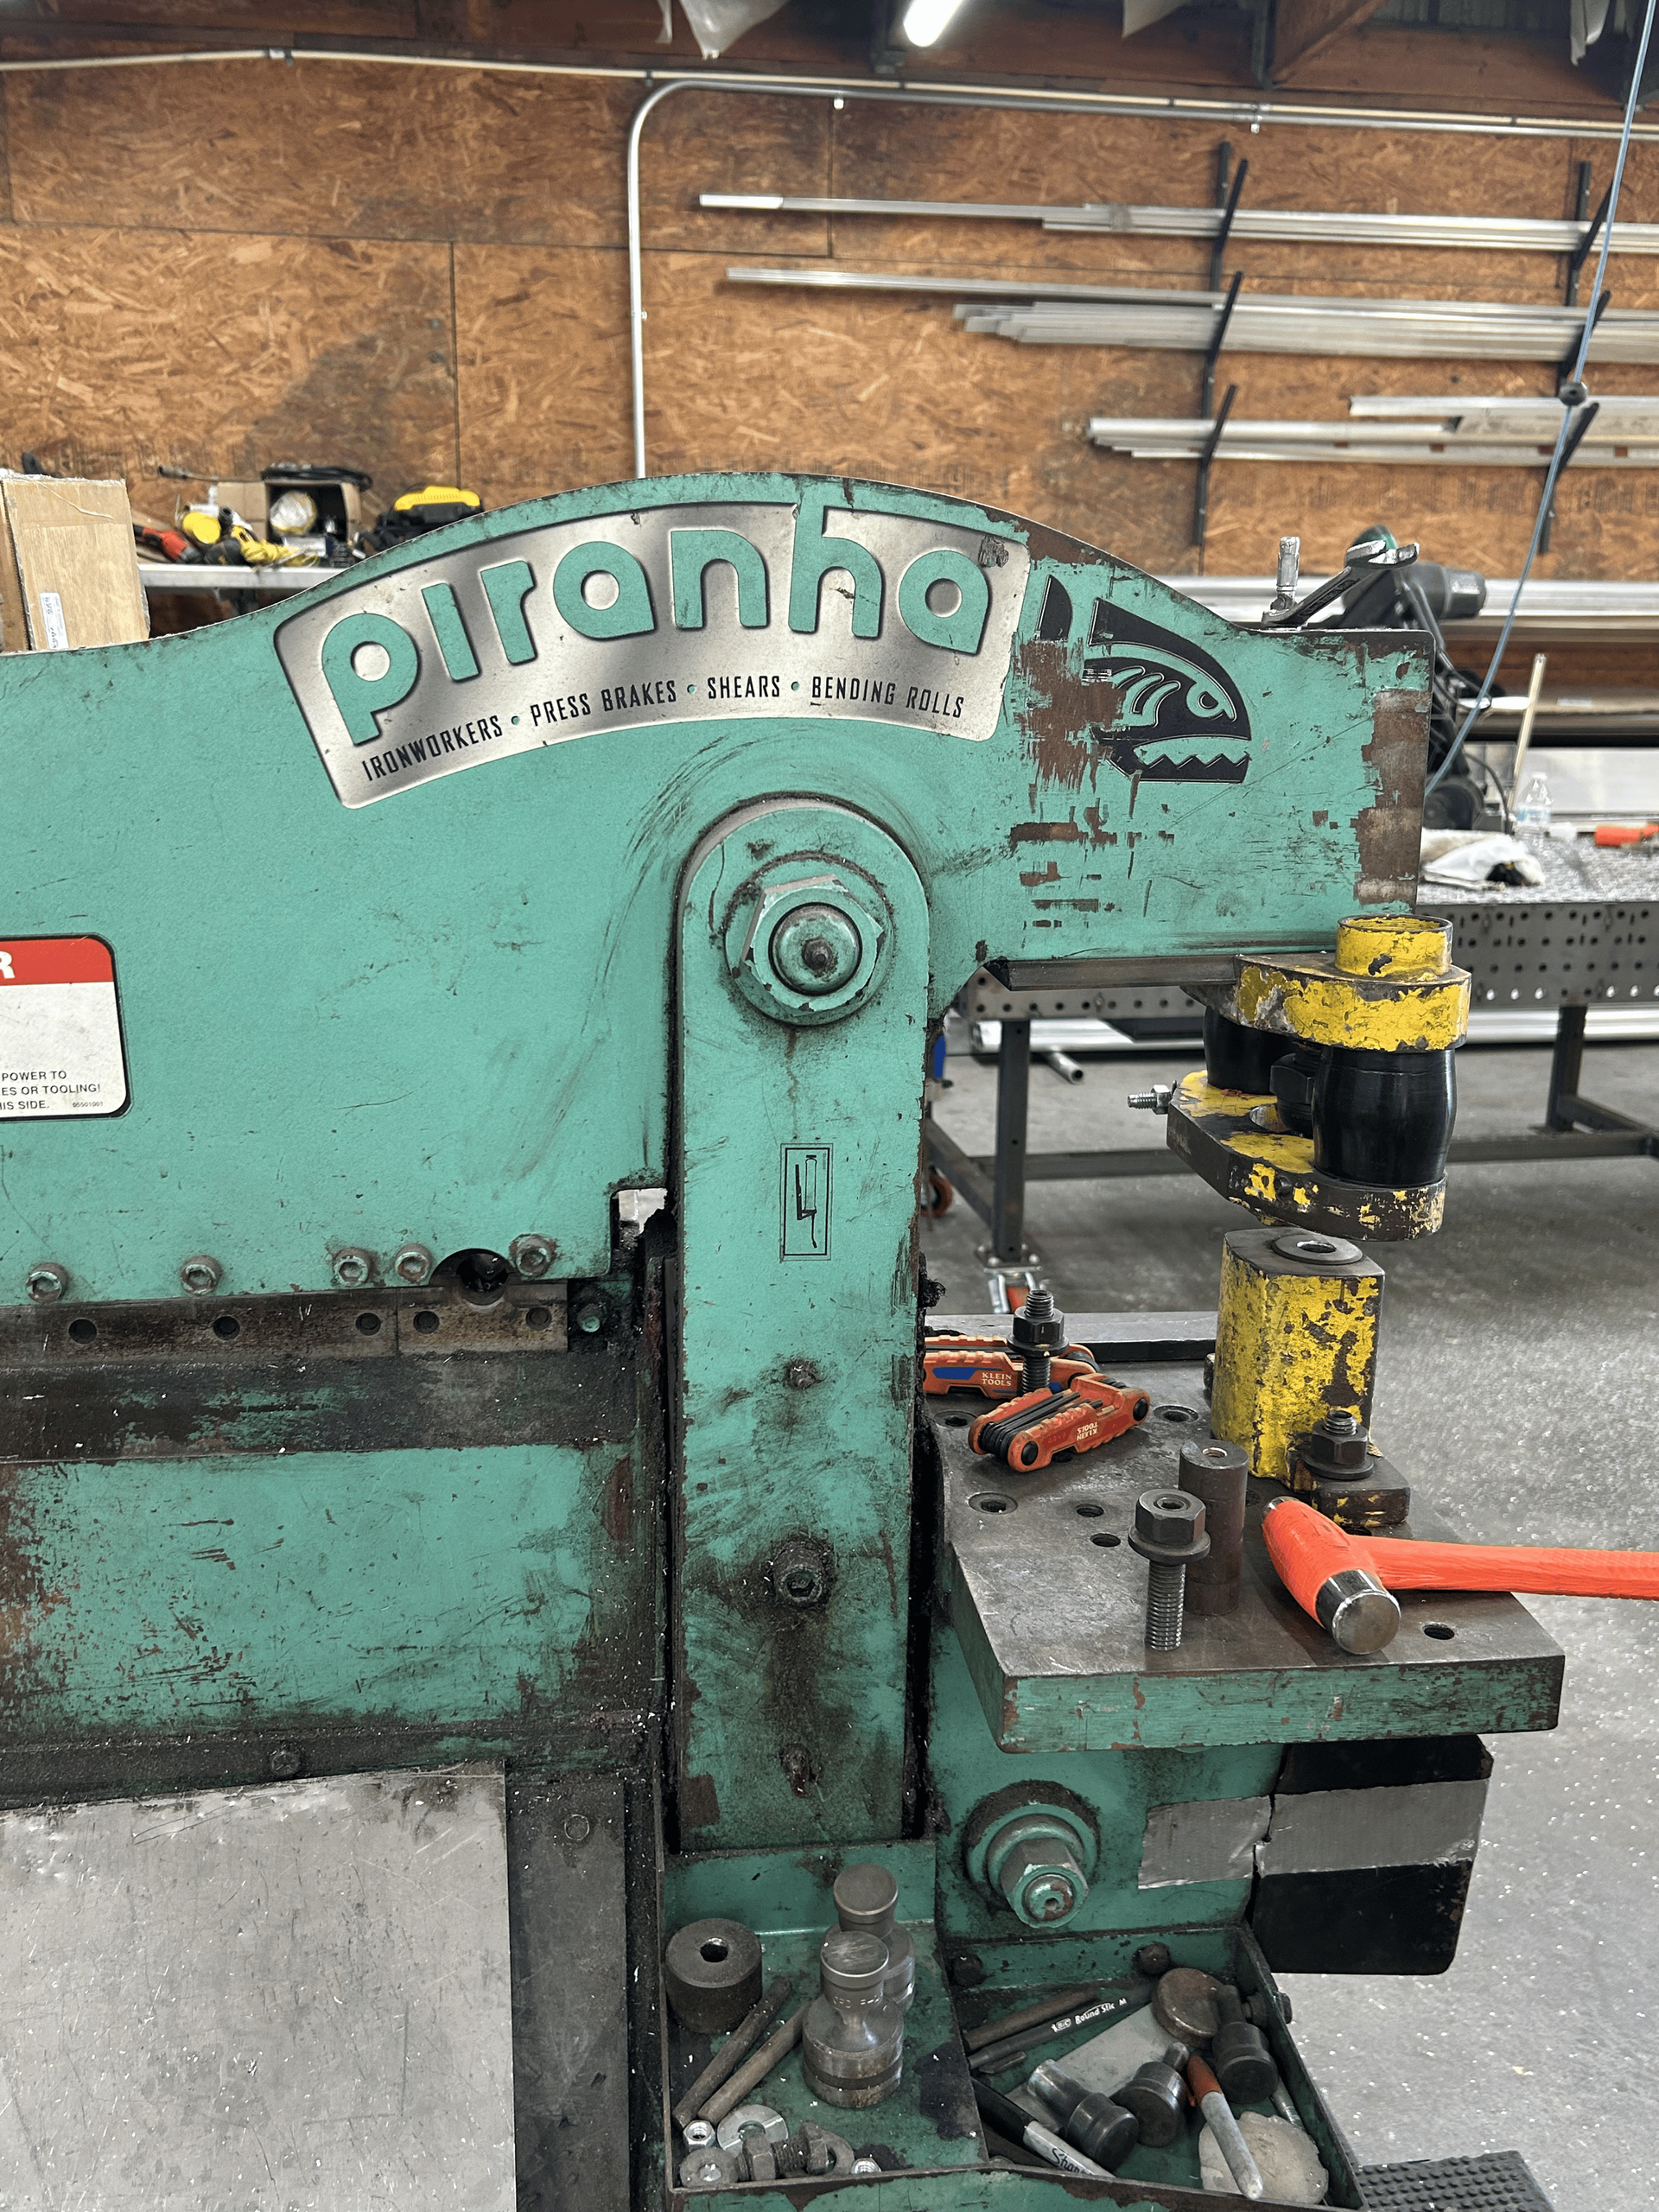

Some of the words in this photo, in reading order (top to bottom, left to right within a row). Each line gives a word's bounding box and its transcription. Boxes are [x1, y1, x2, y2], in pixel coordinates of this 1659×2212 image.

[321, 501, 990, 747] piranha
[362, 715, 503, 781] IRONWORKERS
[530, 693, 591, 727] PRESS
[601, 680, 677, 712] BRAKES
[707, 675, 780, 699] SHEARS
[811, 676, 896, 705] BENDING
[906, 685, 964, 718] ROLLS
[2, 1071, 47, 1081] POWER
[50, 1071, 67, 1079] TO
[0, 1086, 17, 1096] ES
[21, 1085, 39, 1096] OR
[42, 1084, 101, 1094] TOOLING!
[18, 1100, 50, 1110] SIDE.
[982, 1378, 1012, 1387] TOOLS
[1077, 1421, 1098, 1434] TOOLS
[1077, 1427, 1097, 1441] KLEIN
[1074, 2007, 1100, 2024] Round
[1101, 2002, 1116, 2013] Stic
[1119, 1998, 1128, 2006] M
[1046, 2146, 1092, 2174] Shar
